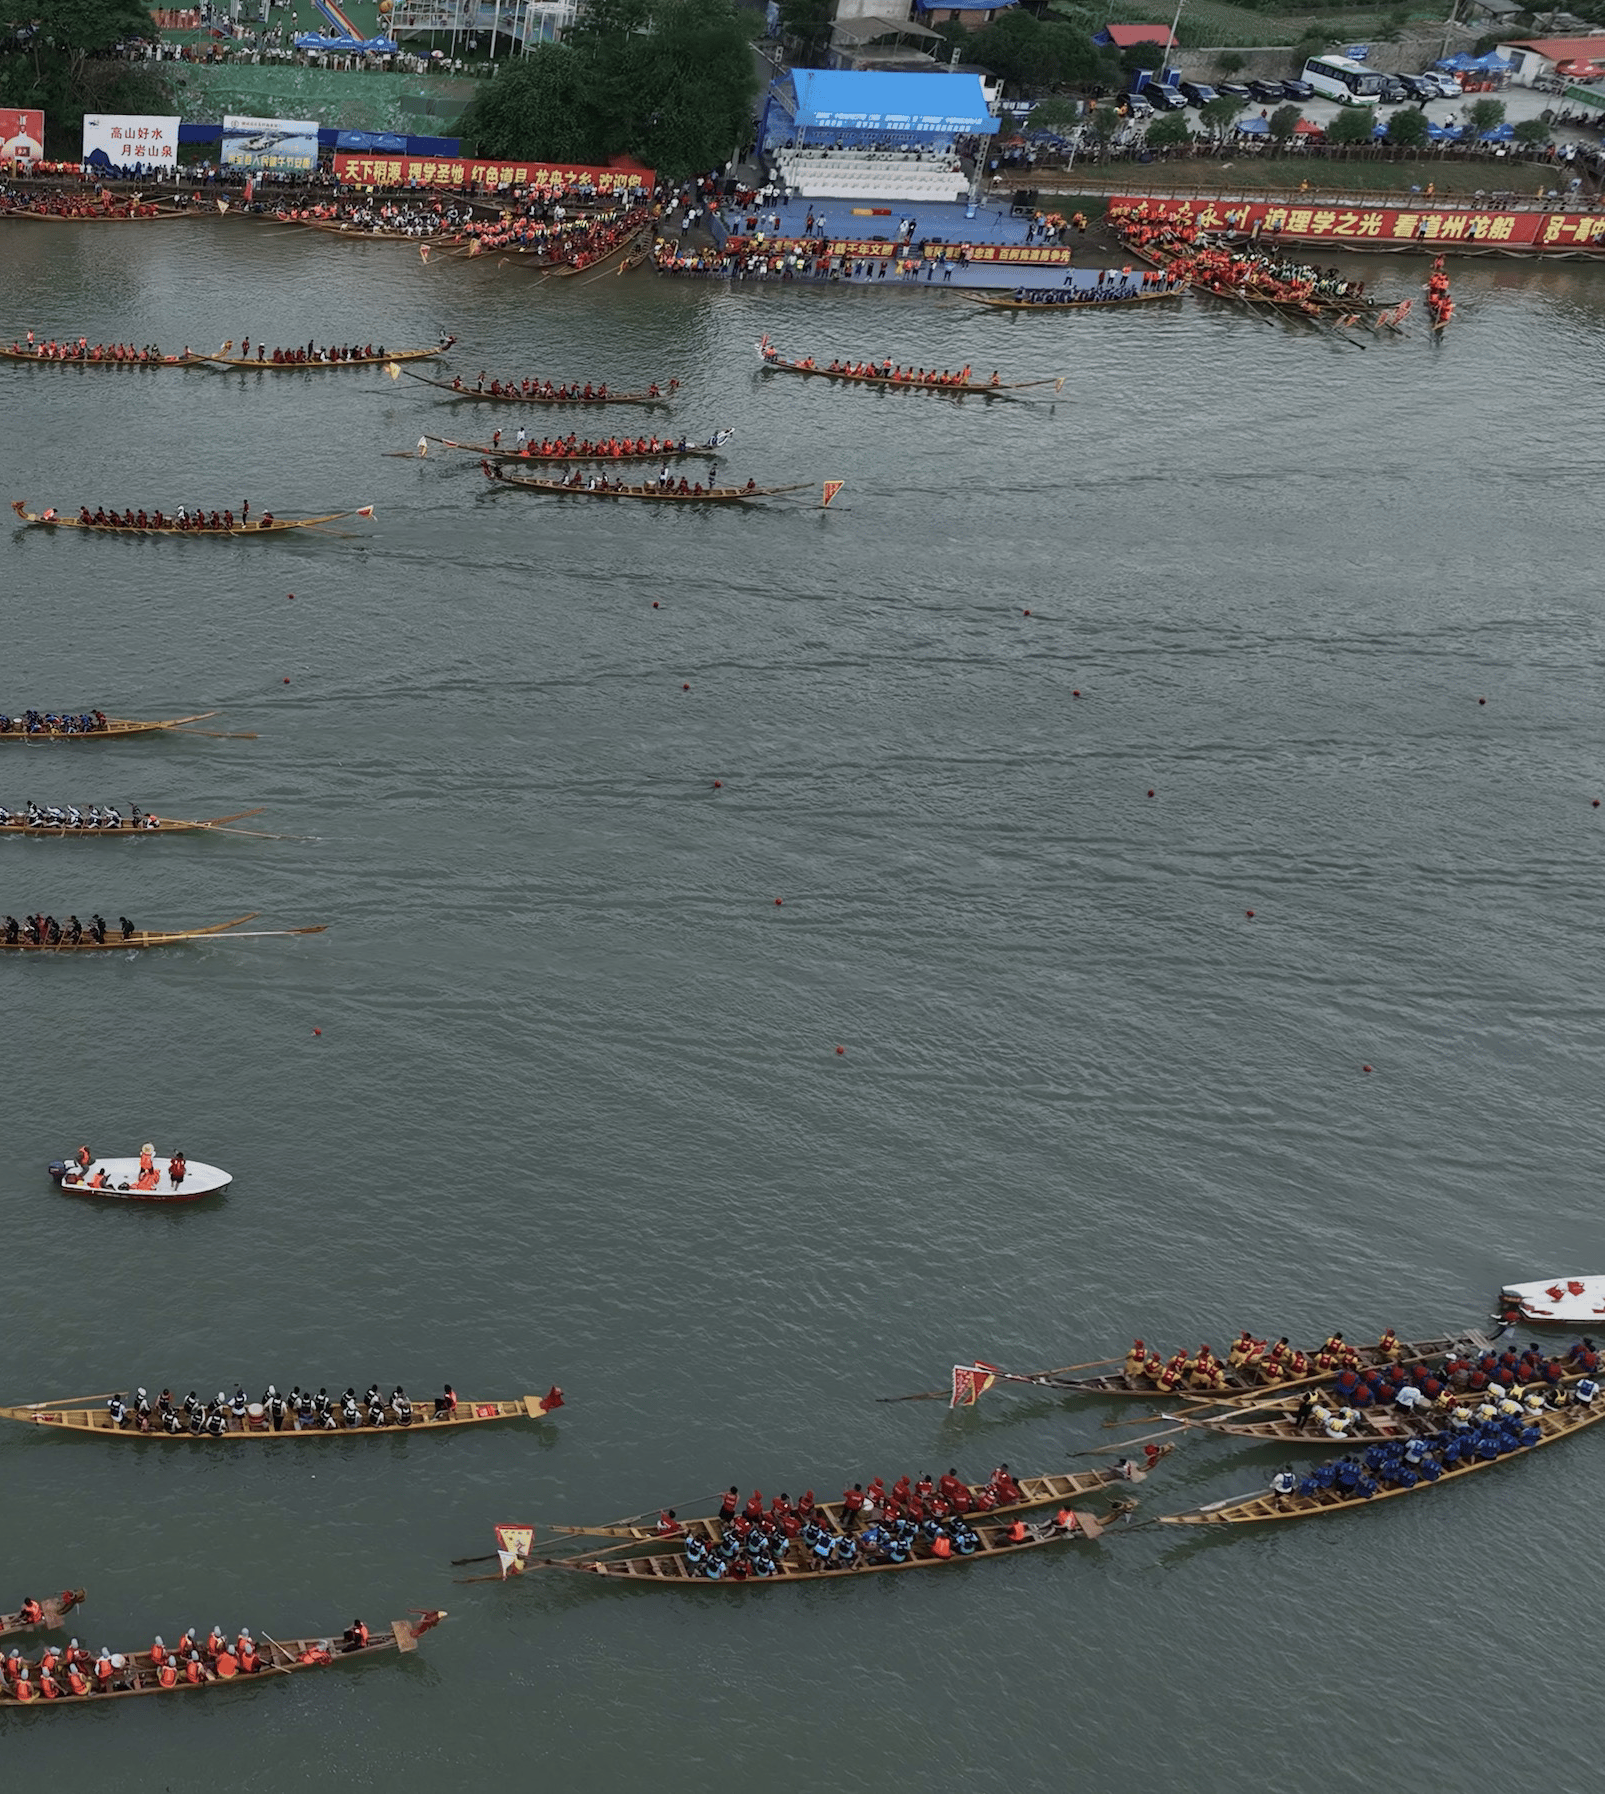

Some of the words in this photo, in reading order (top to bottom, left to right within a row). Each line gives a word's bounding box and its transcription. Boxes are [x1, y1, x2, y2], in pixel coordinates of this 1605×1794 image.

[111, 127, 163, 140] 高山好水
[121, 144, 173, 157] 月岩山泉
[345, 160, 403, 181] 天下稻源
[408, 162, 465, 184] 理学圣地
[535, 169, 592, 187] 龙舟之乡
[1262, 208, 1383, 236] 追理学之光
[1393, 214, 1516, 240] 看道州龙船
